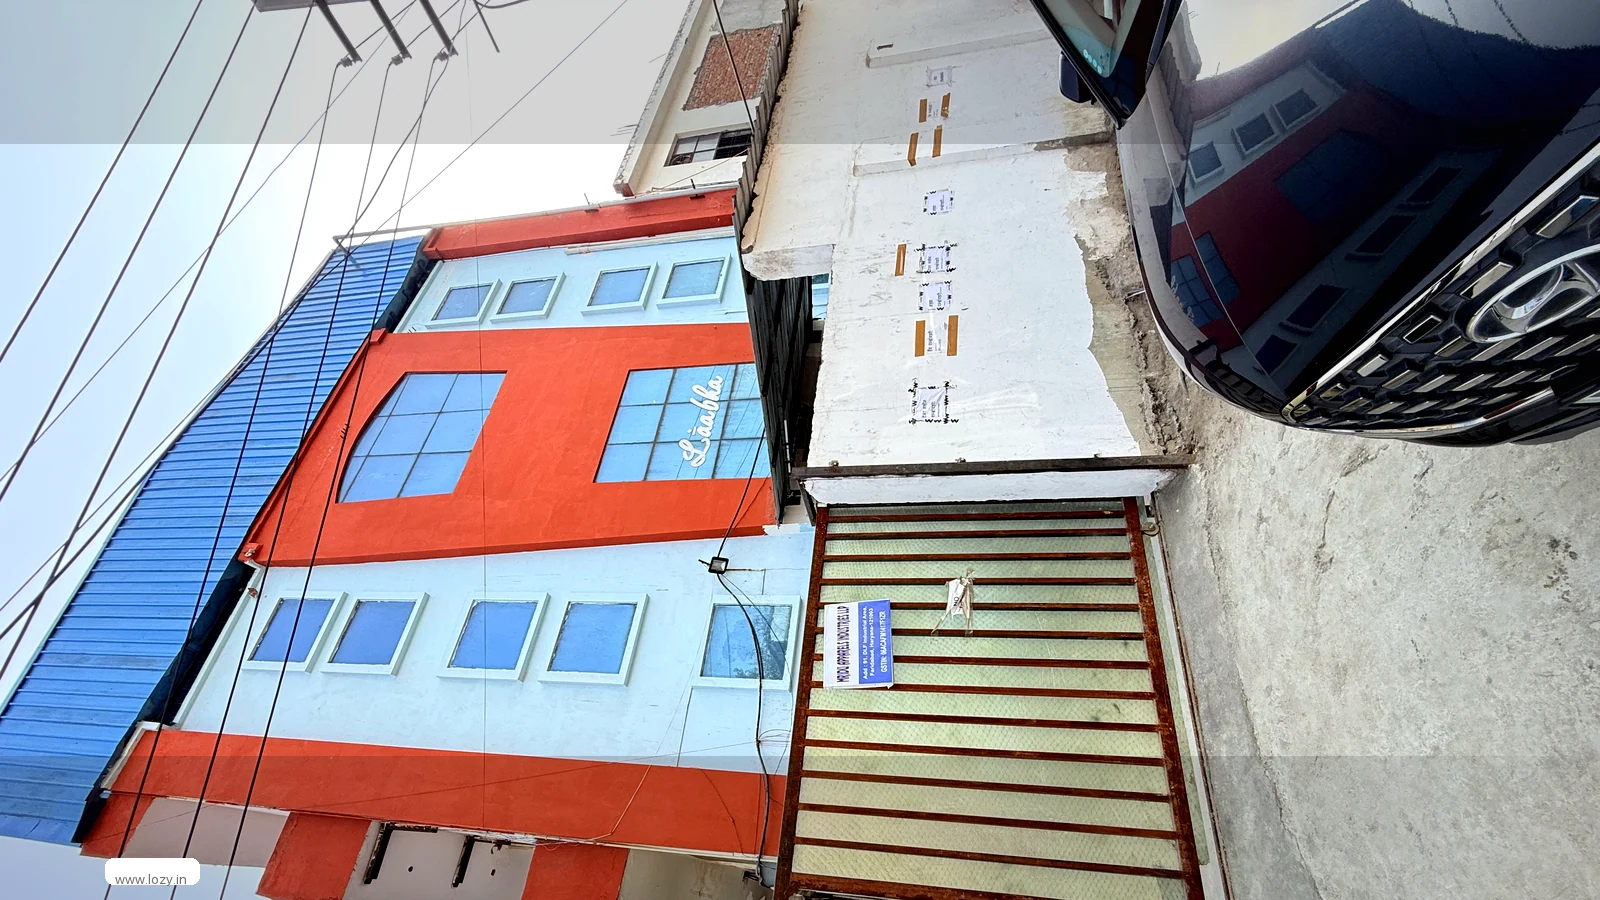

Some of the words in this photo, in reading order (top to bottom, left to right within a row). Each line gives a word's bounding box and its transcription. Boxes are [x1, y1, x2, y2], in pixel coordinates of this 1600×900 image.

[837, 606, 849, 614] LLP
[837, 614, 850, 640] INDUSTRIES
[837, 641, 850, 665] APPARELS
[837, 666, 850, 682] MRIDU
